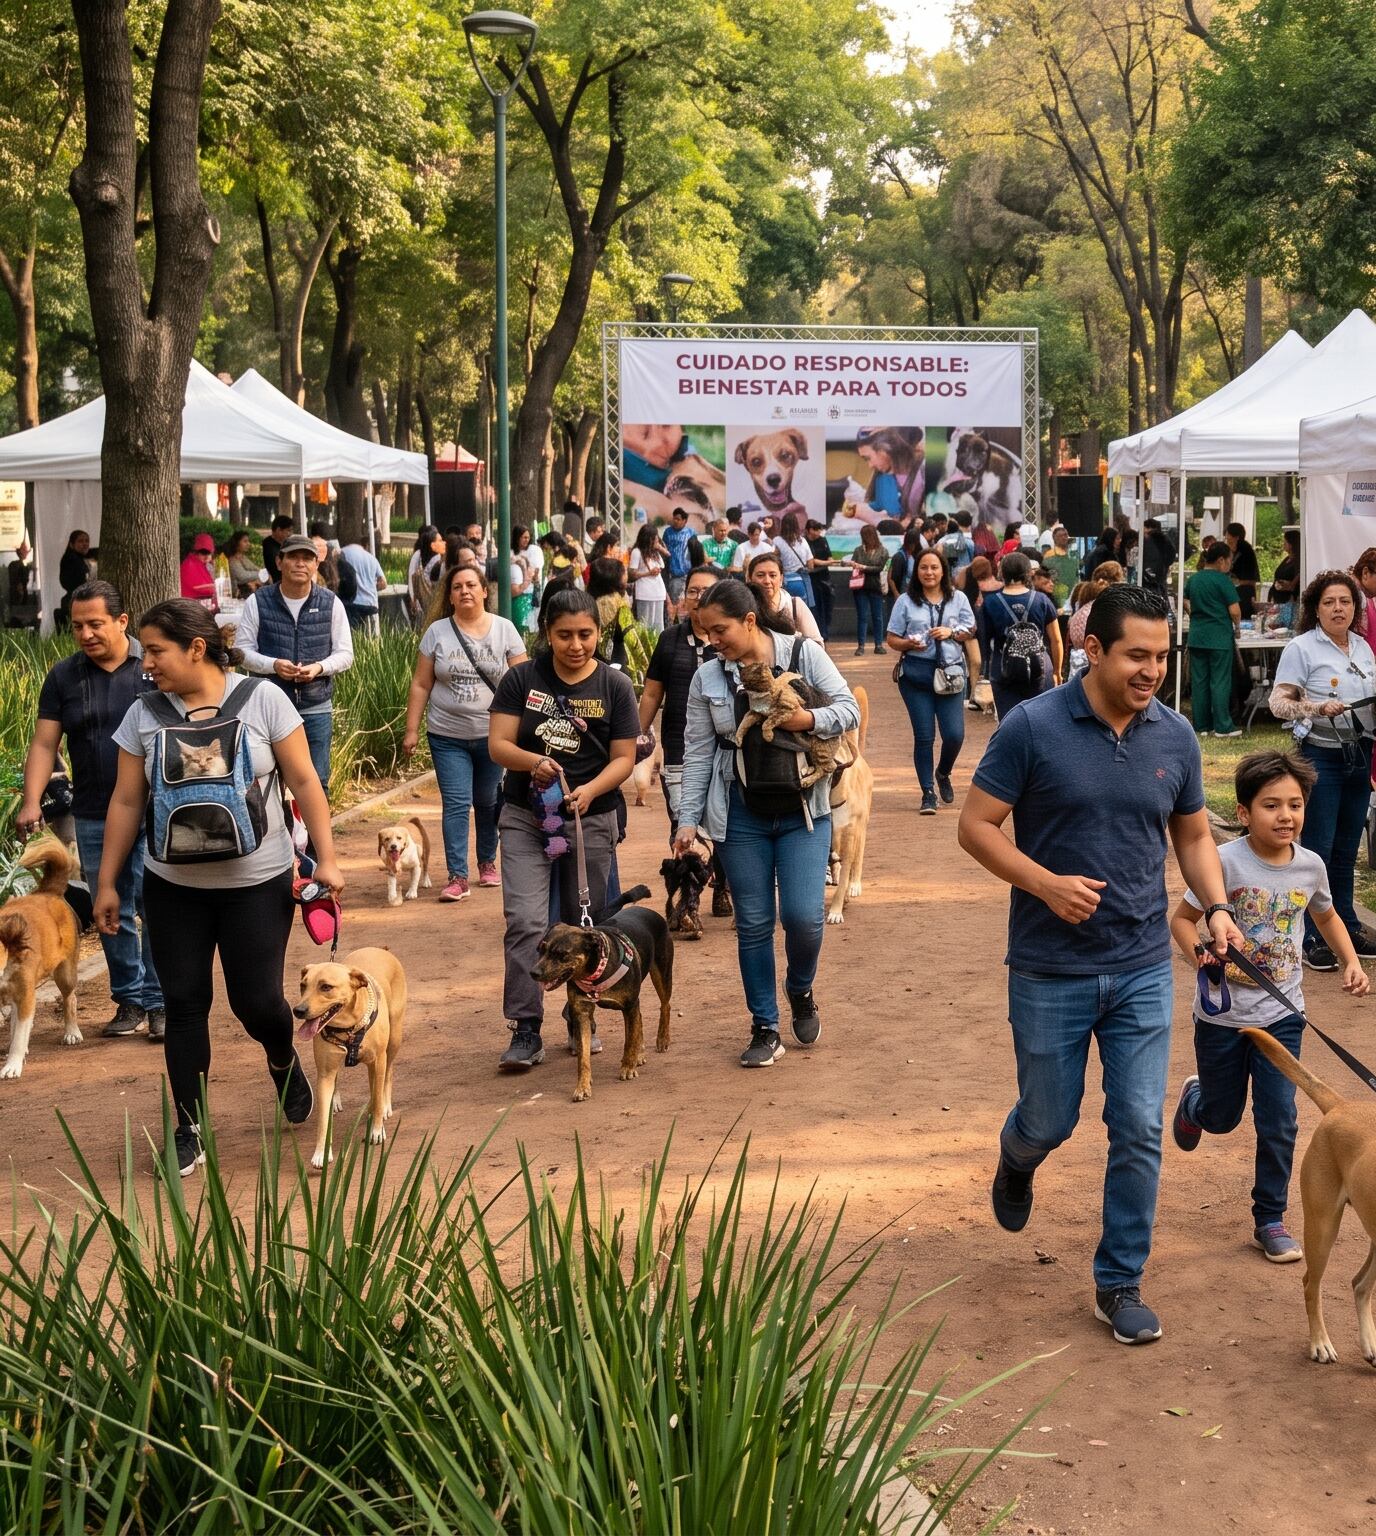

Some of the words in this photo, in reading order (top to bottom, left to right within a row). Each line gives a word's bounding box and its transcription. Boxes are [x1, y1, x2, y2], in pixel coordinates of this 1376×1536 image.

[676, 354, 786, 370] CUIDADO
[793, 355, 970, 373] RESPONSABLE:
[678, 379, 809, 395] BIENESTAR
[817, 380, 881, 396] PARA
[887, 381, 968, 397] TODOS
